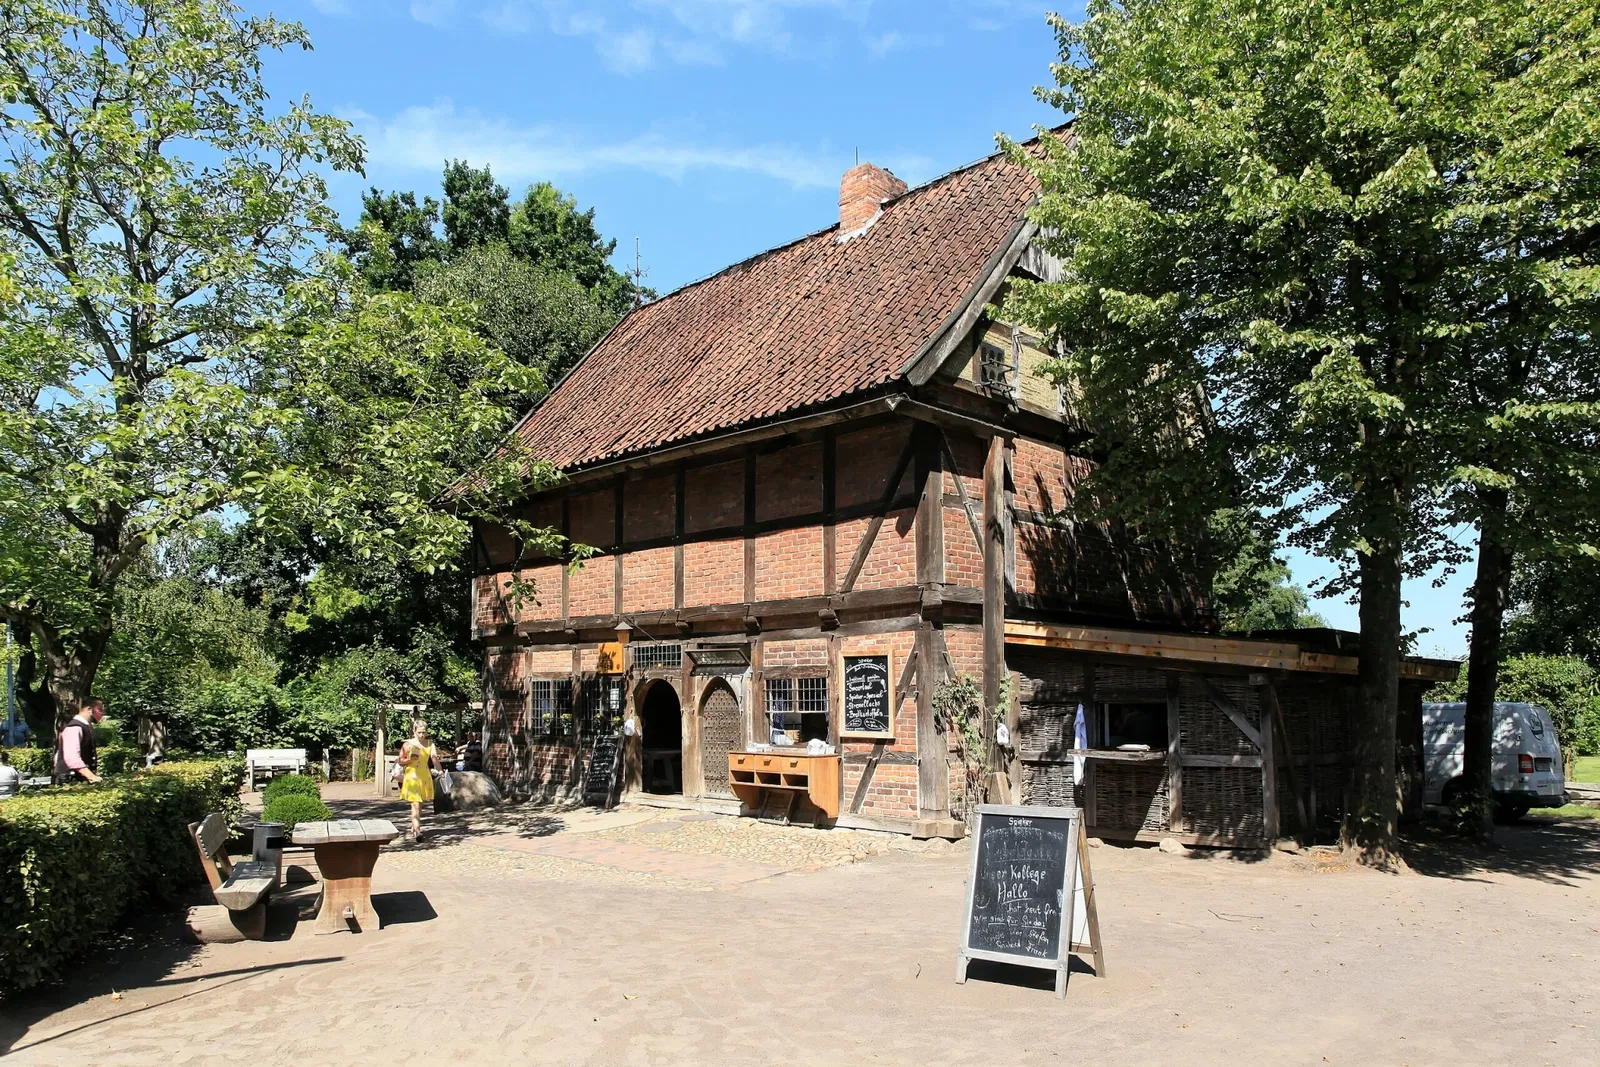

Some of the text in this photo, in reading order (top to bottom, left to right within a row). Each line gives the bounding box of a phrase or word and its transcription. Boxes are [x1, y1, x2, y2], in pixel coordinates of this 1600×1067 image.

[1008, 817, 1033, 826] Spieker
[1010, 864, 1046, 885] Kollege
[997, 881, 1028, 903] Hallo
